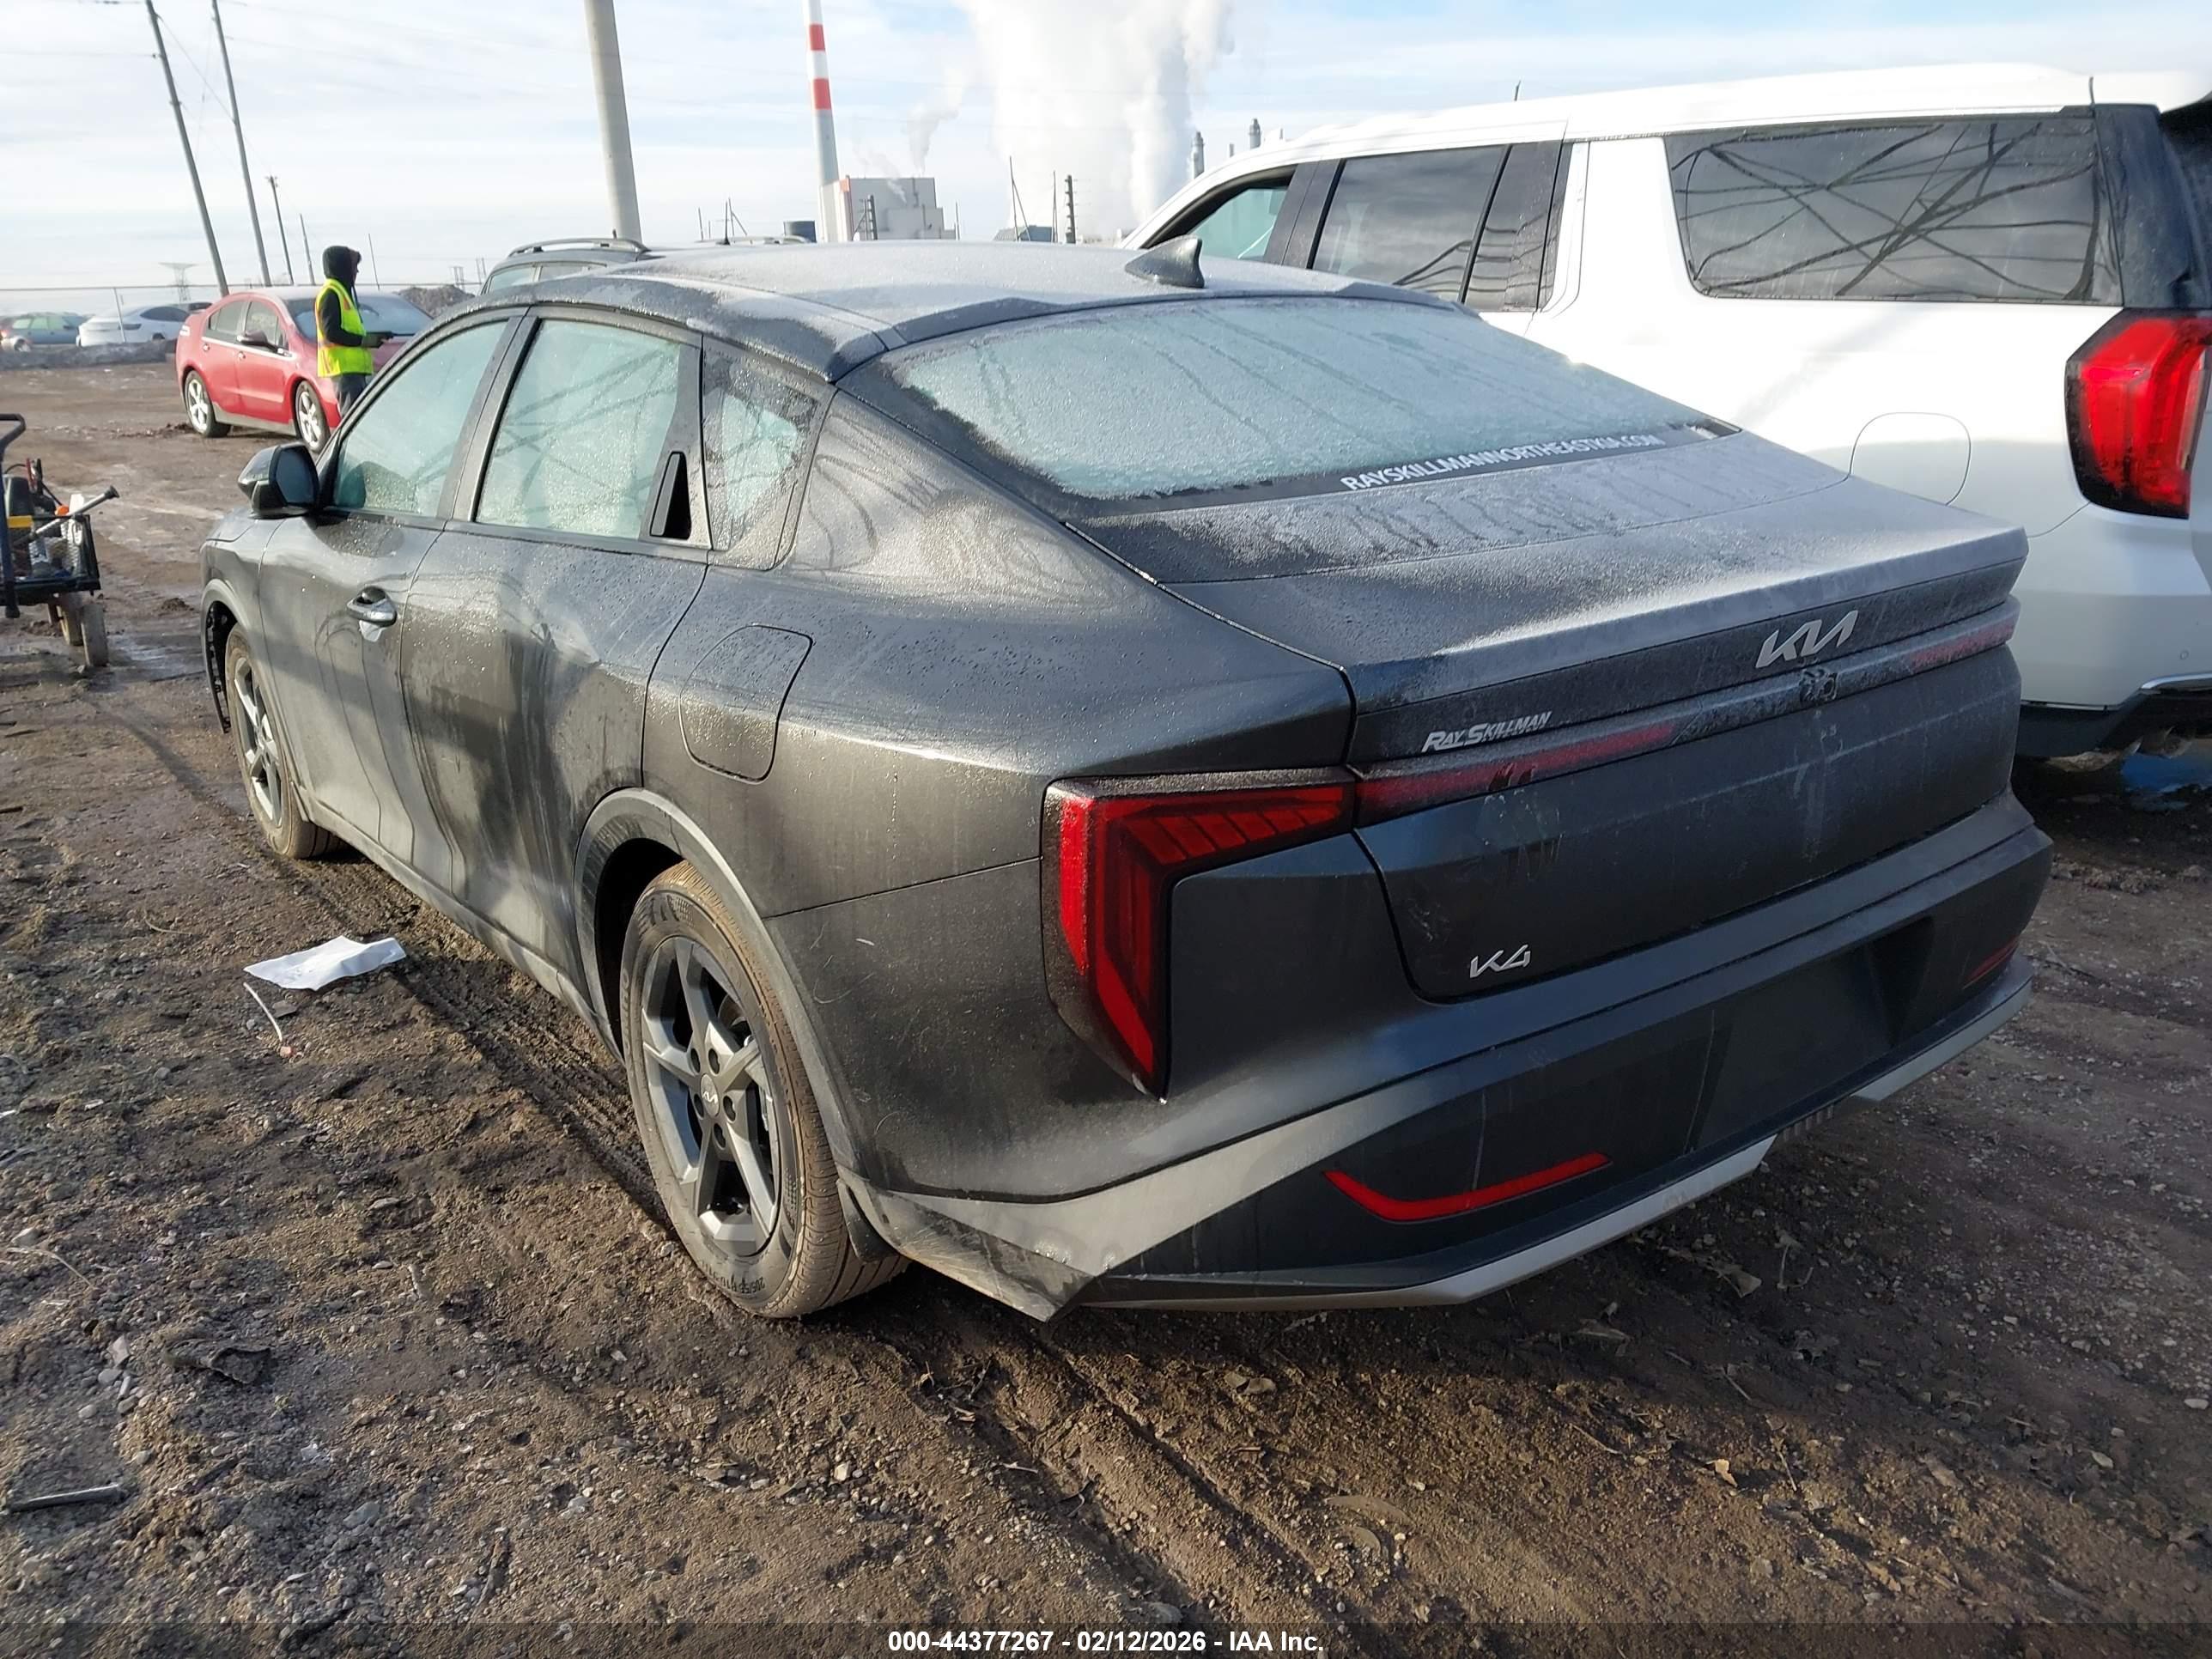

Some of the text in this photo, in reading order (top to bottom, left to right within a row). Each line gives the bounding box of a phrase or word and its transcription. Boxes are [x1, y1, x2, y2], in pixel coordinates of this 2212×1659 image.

[1340, 434, 1666, 490] RAYSKILLMANNORTHEASTKIA.COM
[1755, 610, 1859, 669] KIA
[1469, 944, 1531, 979] K4
